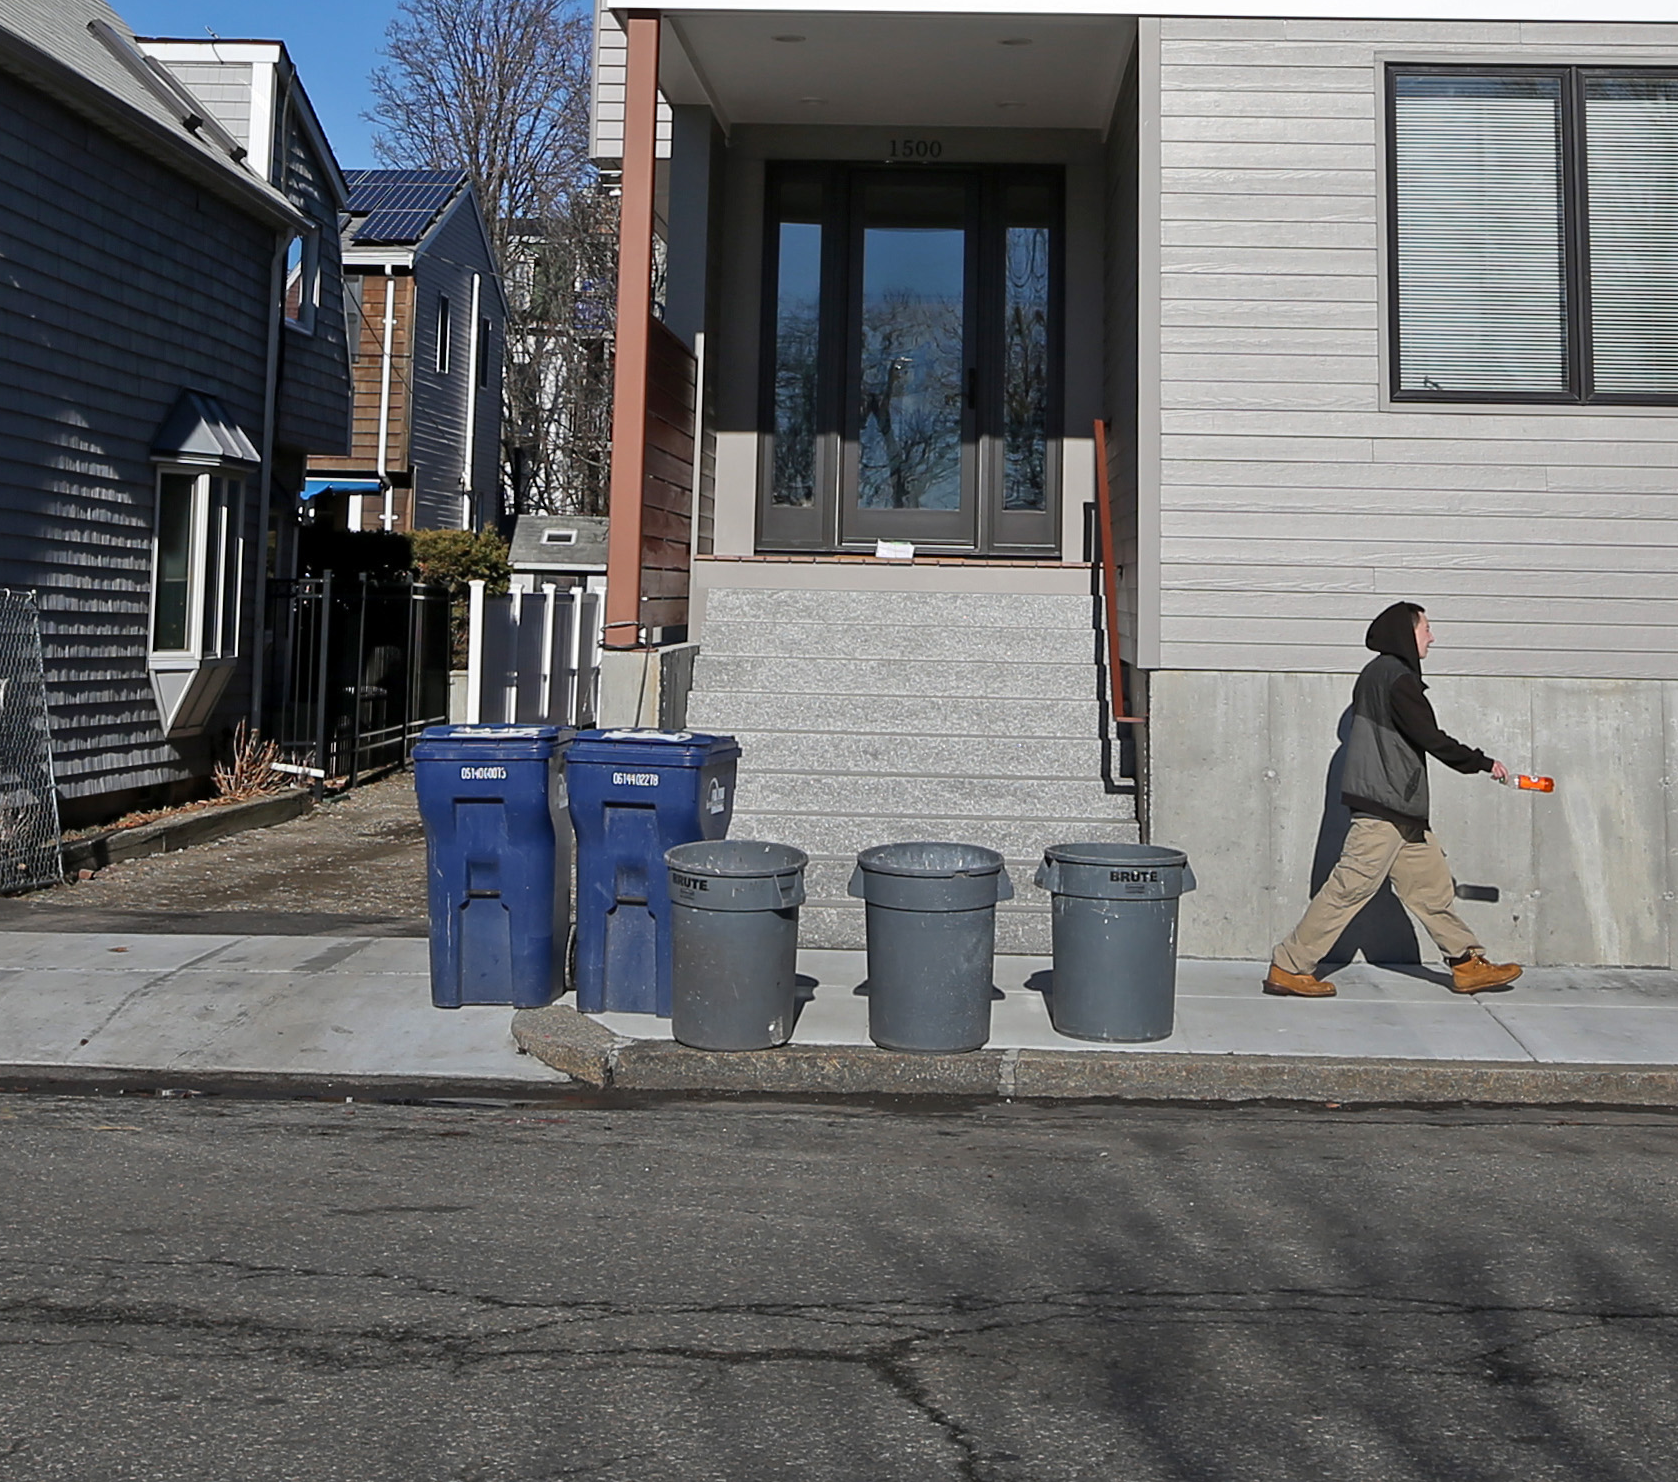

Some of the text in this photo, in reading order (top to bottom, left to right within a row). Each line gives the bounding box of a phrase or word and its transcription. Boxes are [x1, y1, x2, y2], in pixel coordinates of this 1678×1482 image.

[889, 139, 942, 158] 1500
[672, 872, 709, 892] BRUTE
[1109, 871, 1158, 883] BRUTE
